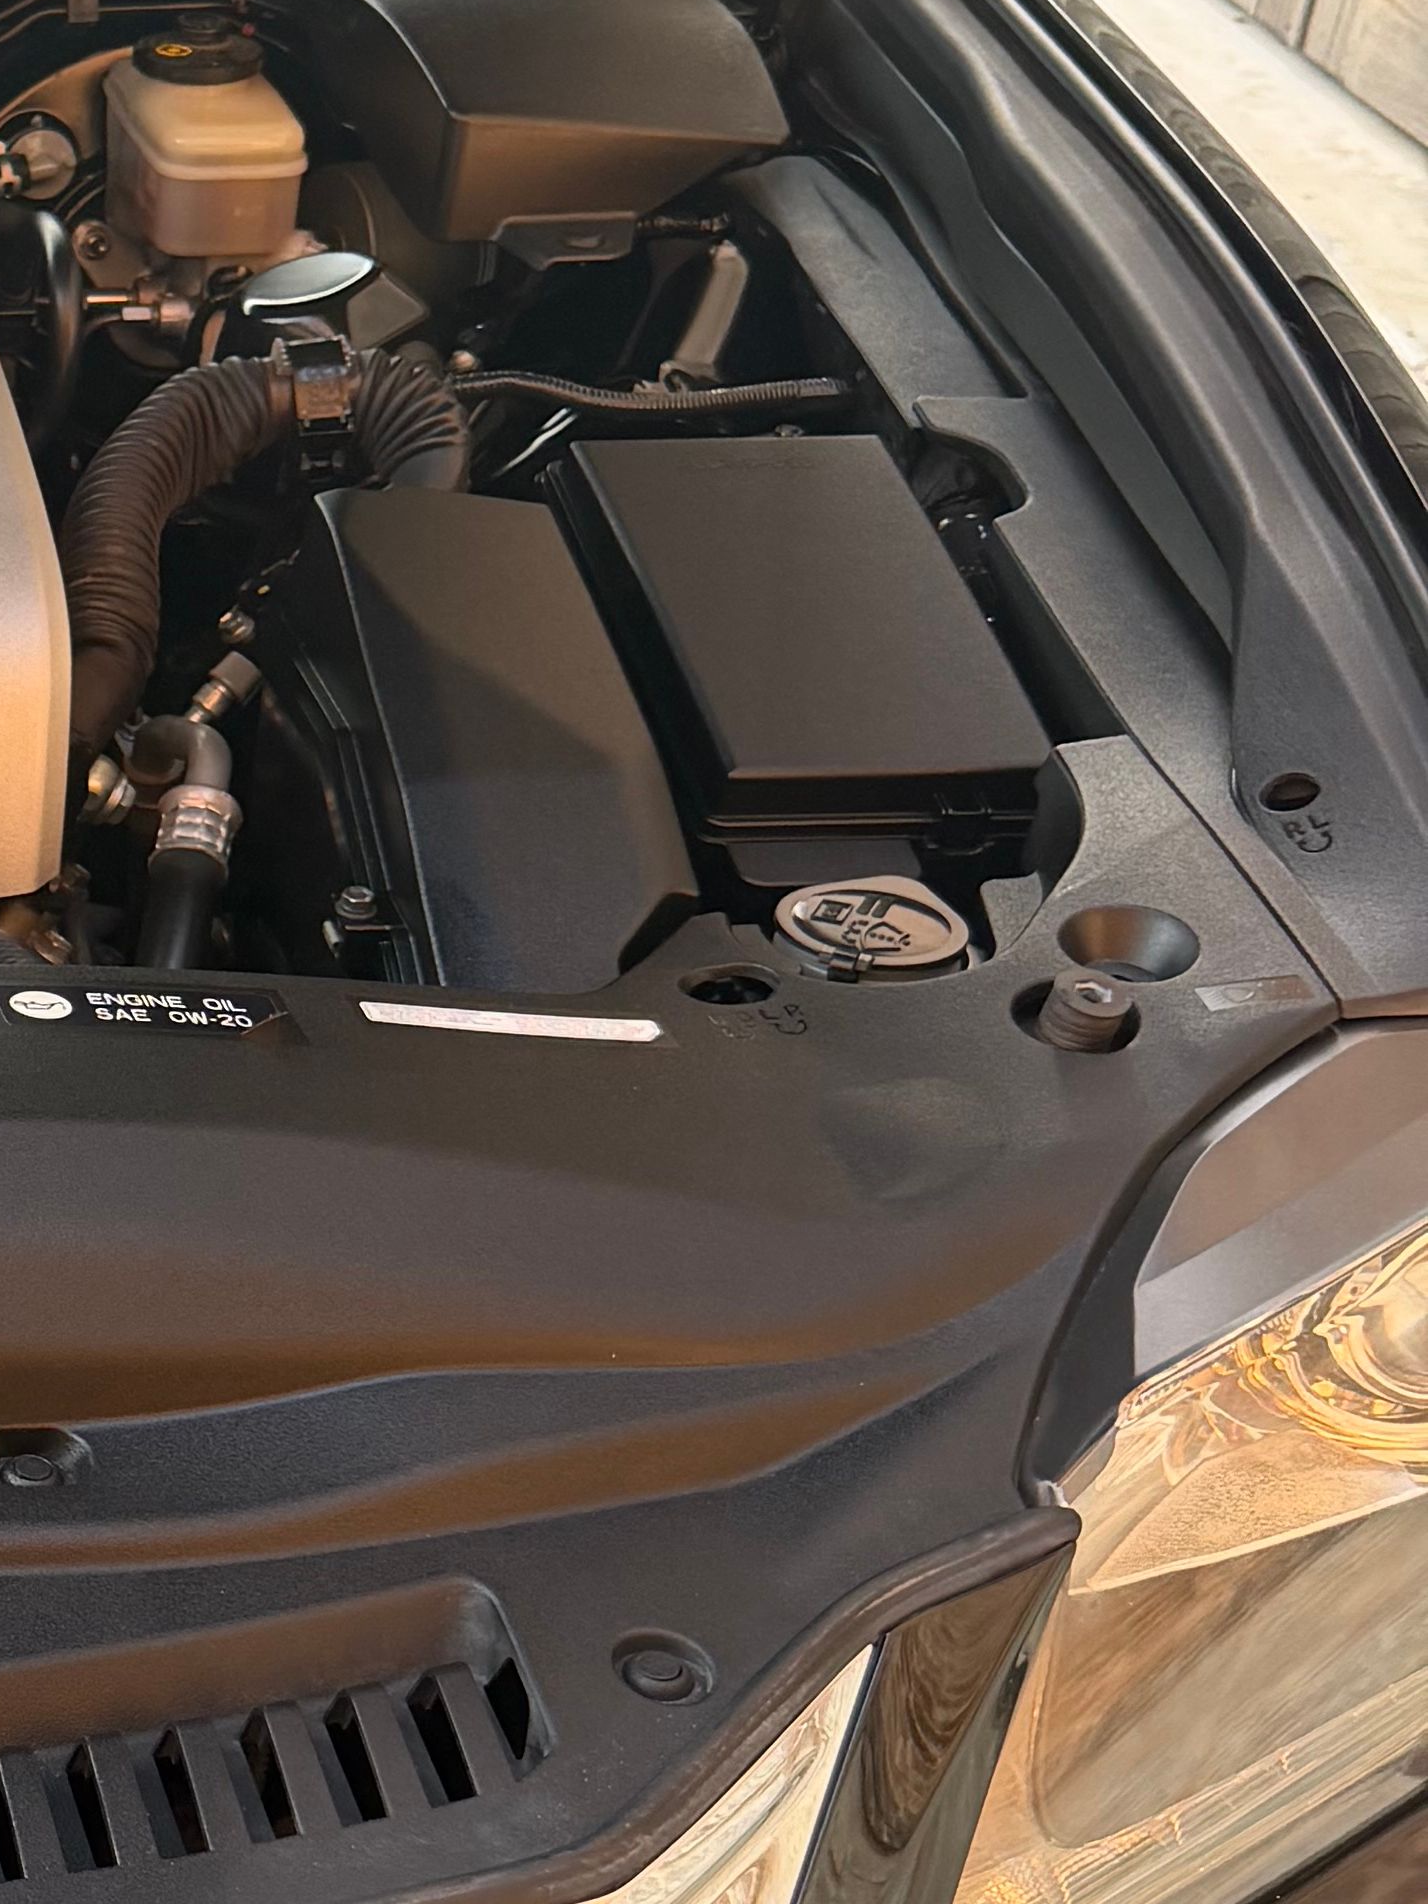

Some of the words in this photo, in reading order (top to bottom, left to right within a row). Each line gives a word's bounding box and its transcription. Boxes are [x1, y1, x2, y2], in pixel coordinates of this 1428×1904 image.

[86, 992, 186, 1009] ENGINE
[202, 998, 247, 1013] OIL
[95, 1007, 152, 1023] SAE
[169, 1012, 253, 1028] 0W-20
